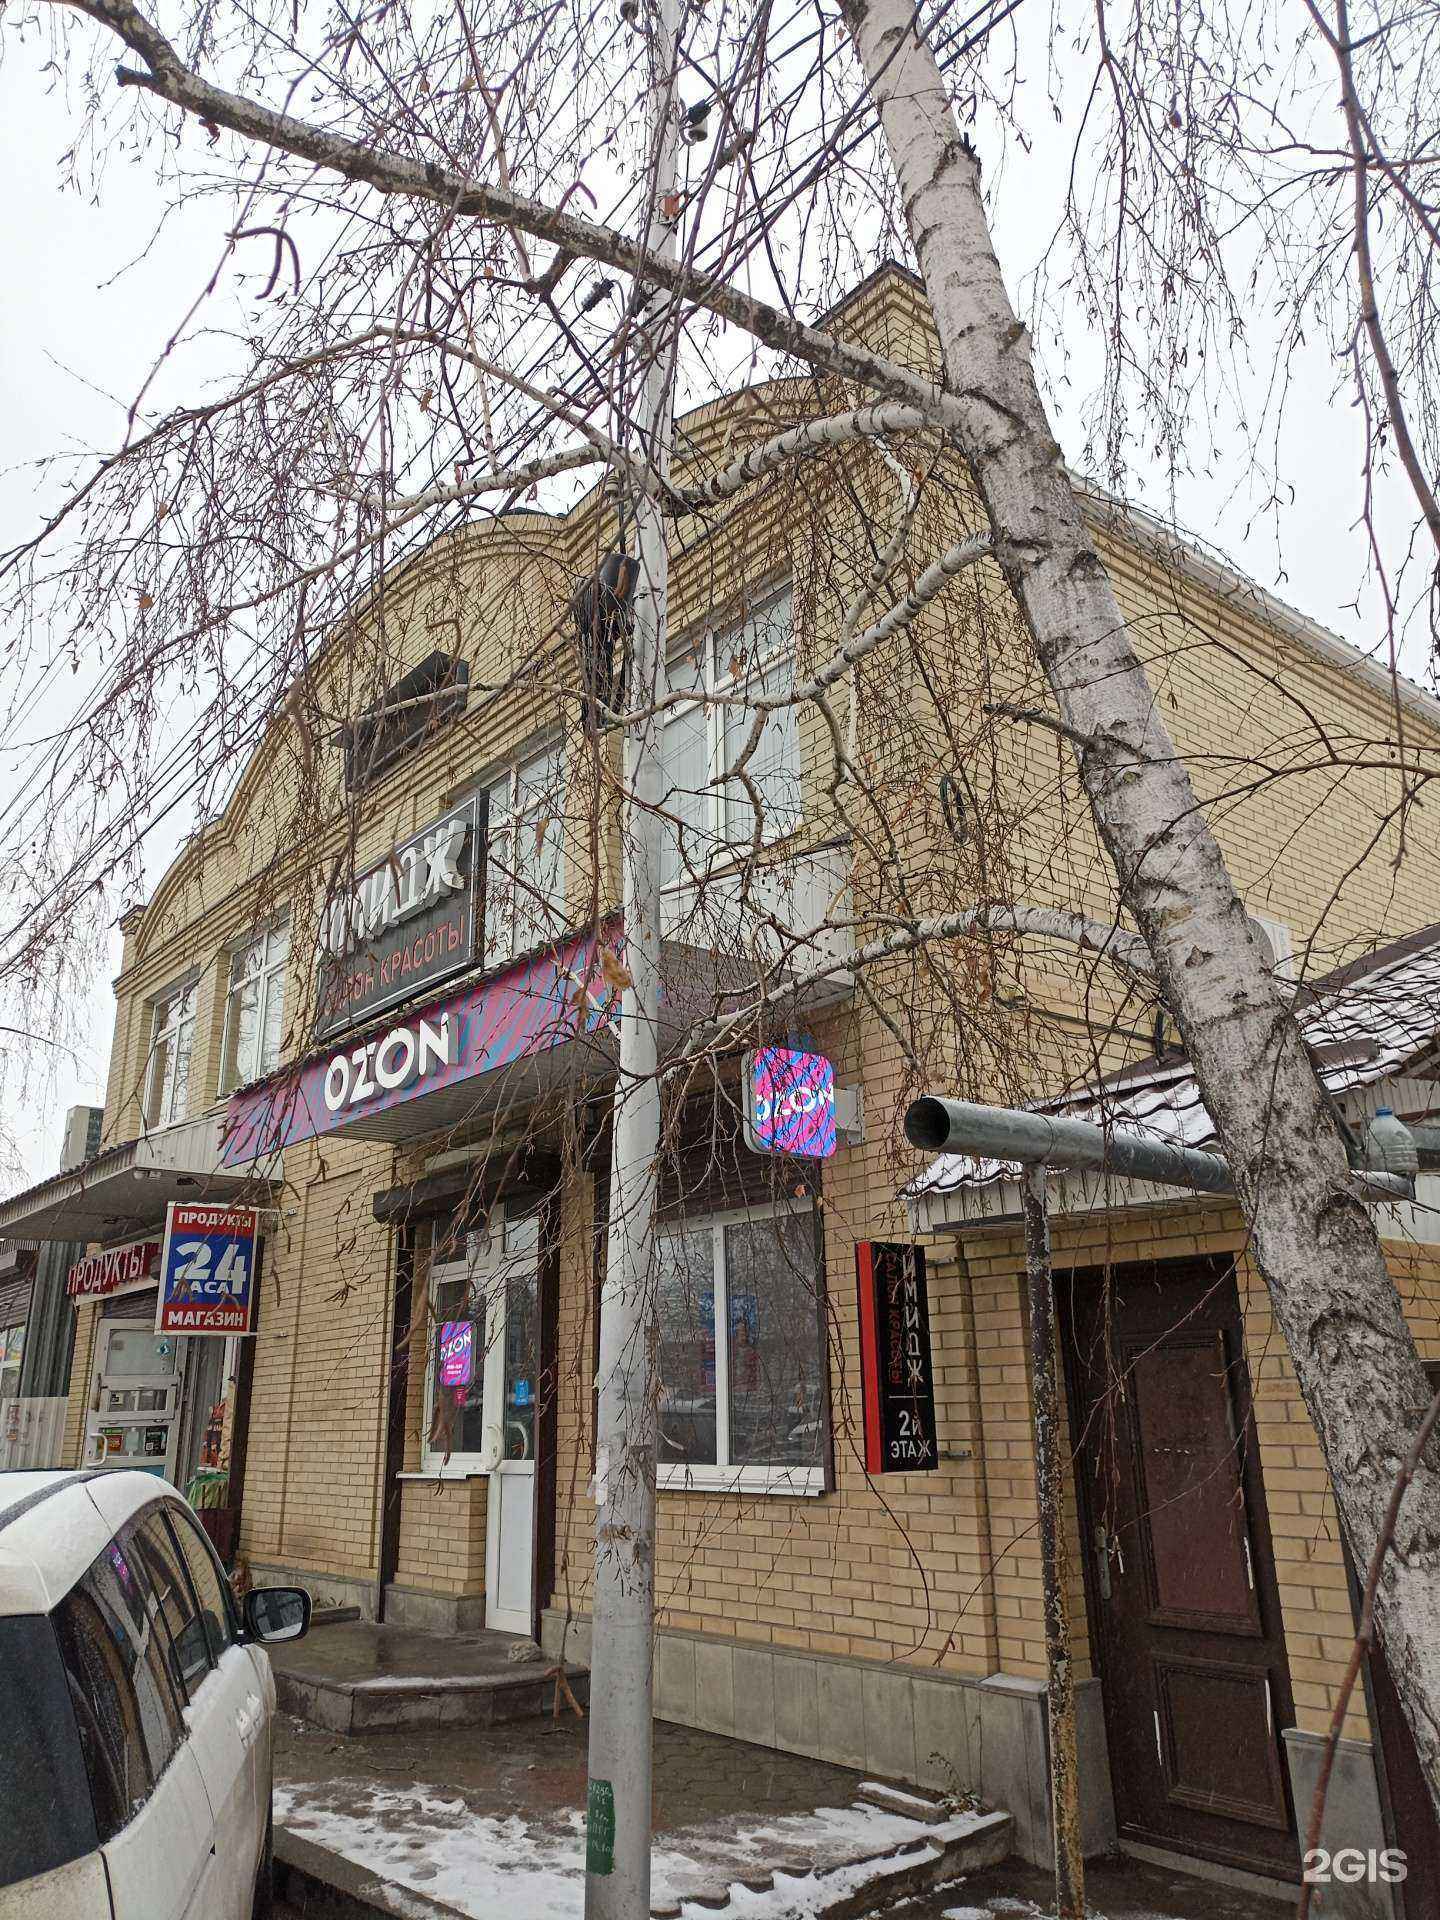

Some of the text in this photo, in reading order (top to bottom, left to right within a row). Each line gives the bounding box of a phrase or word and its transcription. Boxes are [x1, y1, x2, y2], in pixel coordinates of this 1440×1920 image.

[380, 915, 464, 987] КРАСОТЫ
[324, 1011, 450, 1112] OZON
[755, 1082, 835, 1121] OZON
[178, 1211, 252, 1228] ПРОДУКТЫ
[67, 1246, 146, 1297] ПРОДУКТЫ
[173, 1241, 247, 1295] 24
[174, 1280, 230, 1295] АСА
[167, 1311, 244, 1327] МАГАЗИН
[890, 1439, 932, 1459] ЭТАЖ
